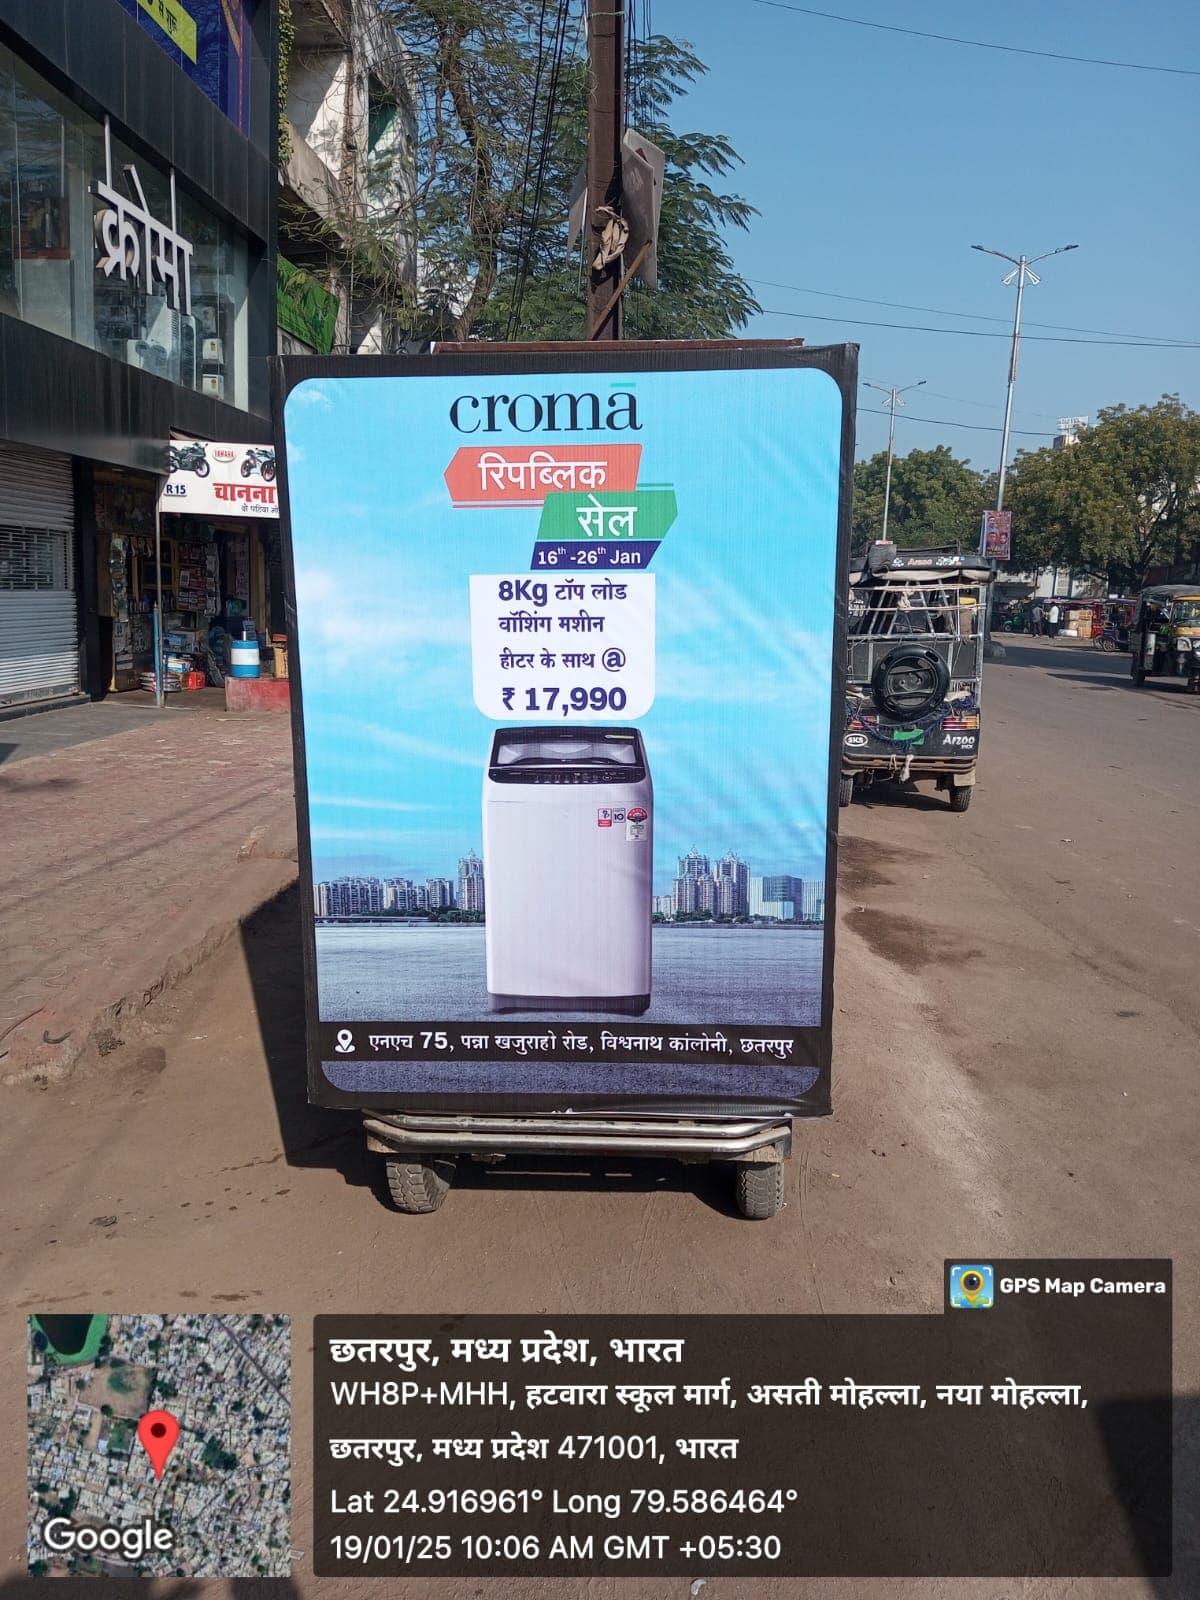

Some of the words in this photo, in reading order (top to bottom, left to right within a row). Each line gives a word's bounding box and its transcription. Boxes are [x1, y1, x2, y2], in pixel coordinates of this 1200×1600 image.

[88, 164, 194, 316] क्रोमा
[477, 451, 608, 490] रिपब्लिक
[166, 485, 173, 494] R
[175, 485, 186, 495] 15
[576, 493, 638, 537] सेल
[609, 550, 641, 564] Jan
[498, 580, 548, 607] 8Kg
[554, 578, 585, 600] टॉप
[591, 577, 628, 600] लोड
[498, 610, 552, 632] वॉशिंग
[558, 609, 605, 632] मशीन
[499, 647, 534, 670] हीटर
[540, 647, 556, 669] के
[562, 653, 595, 669] साथ
[602, 647, 626, 672] @
[502, 687, 515, 711] ₹
[525, 686, 627, 717] 17,990
[942, 733, 975, 745] Arzoo
[369, 1034, 413, 1051] एनएच
[420, 1031, 454, 1053] 75,
[460, 1035, 489, 1049] पन्ना
[495, 1030, 557, 1056] खजुराहो
[562, 1031, 594, 1054] रोड,
[740, 1037, 794, 1060] छतरपुर
